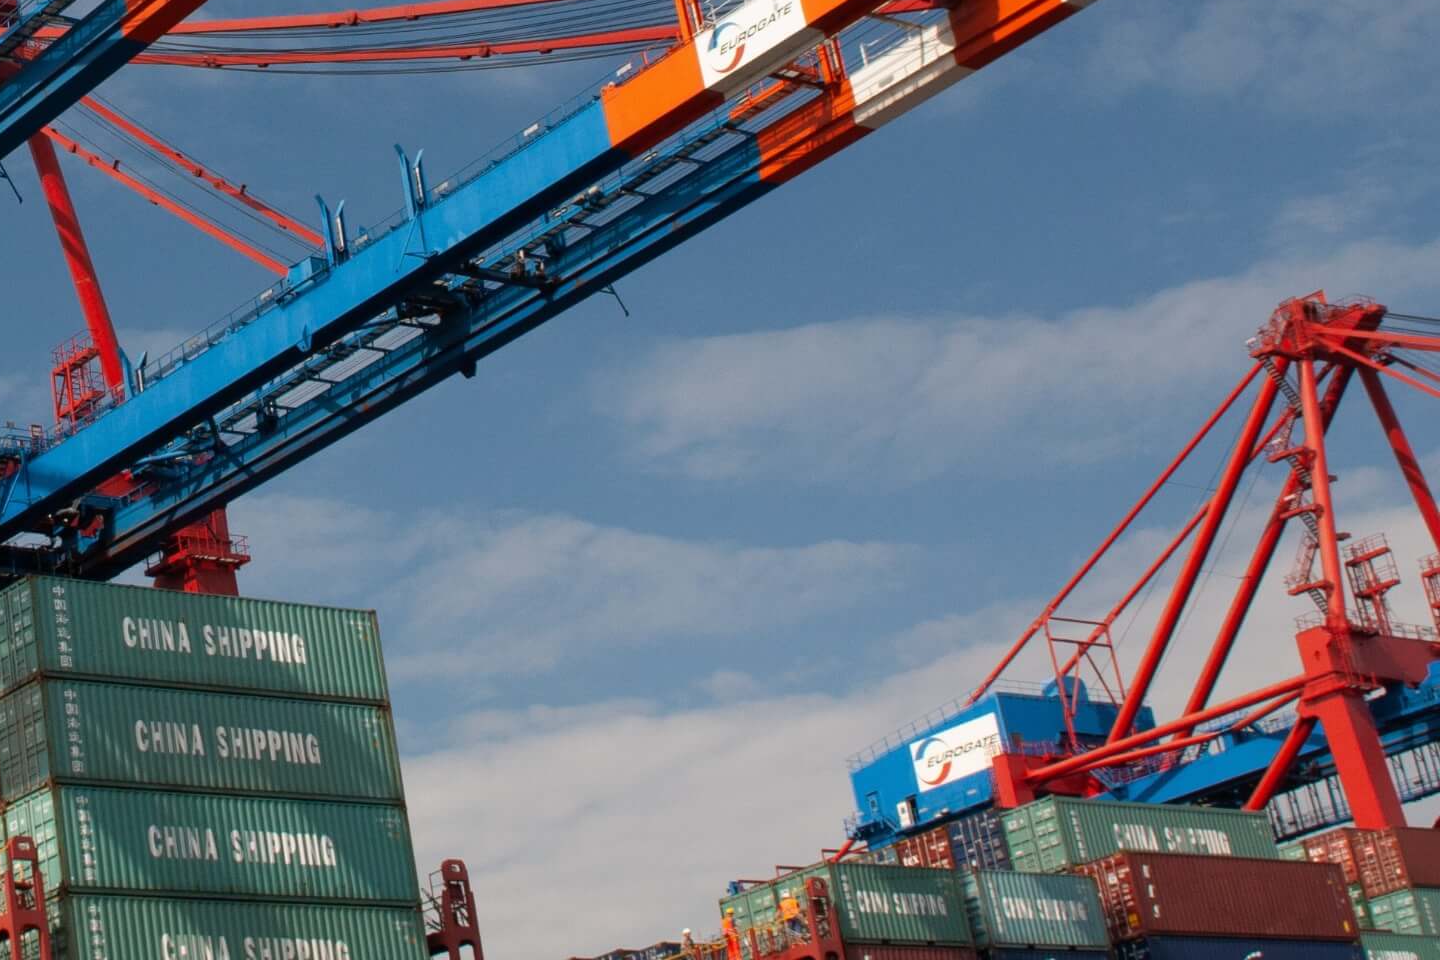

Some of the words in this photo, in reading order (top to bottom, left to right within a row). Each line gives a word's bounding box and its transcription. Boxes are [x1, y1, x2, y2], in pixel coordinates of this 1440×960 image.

[719, 1, 793, 55] EUROGATE
[122, 616, 192, 654] CHINA
[202, 624, 307, 664] SHIPPING
[135, 719, 205, 756] CHINA
[215, 725, 321, 765] SHIPPING
[927, 733, 998, 768] EUROGATE
[148, 824, 219, 861] CHINA
[230, 829, 337, 867] SHIPPING
[162, 933, 231, 960] CHINA
[244, 936, 351, 960] SHIPPING
